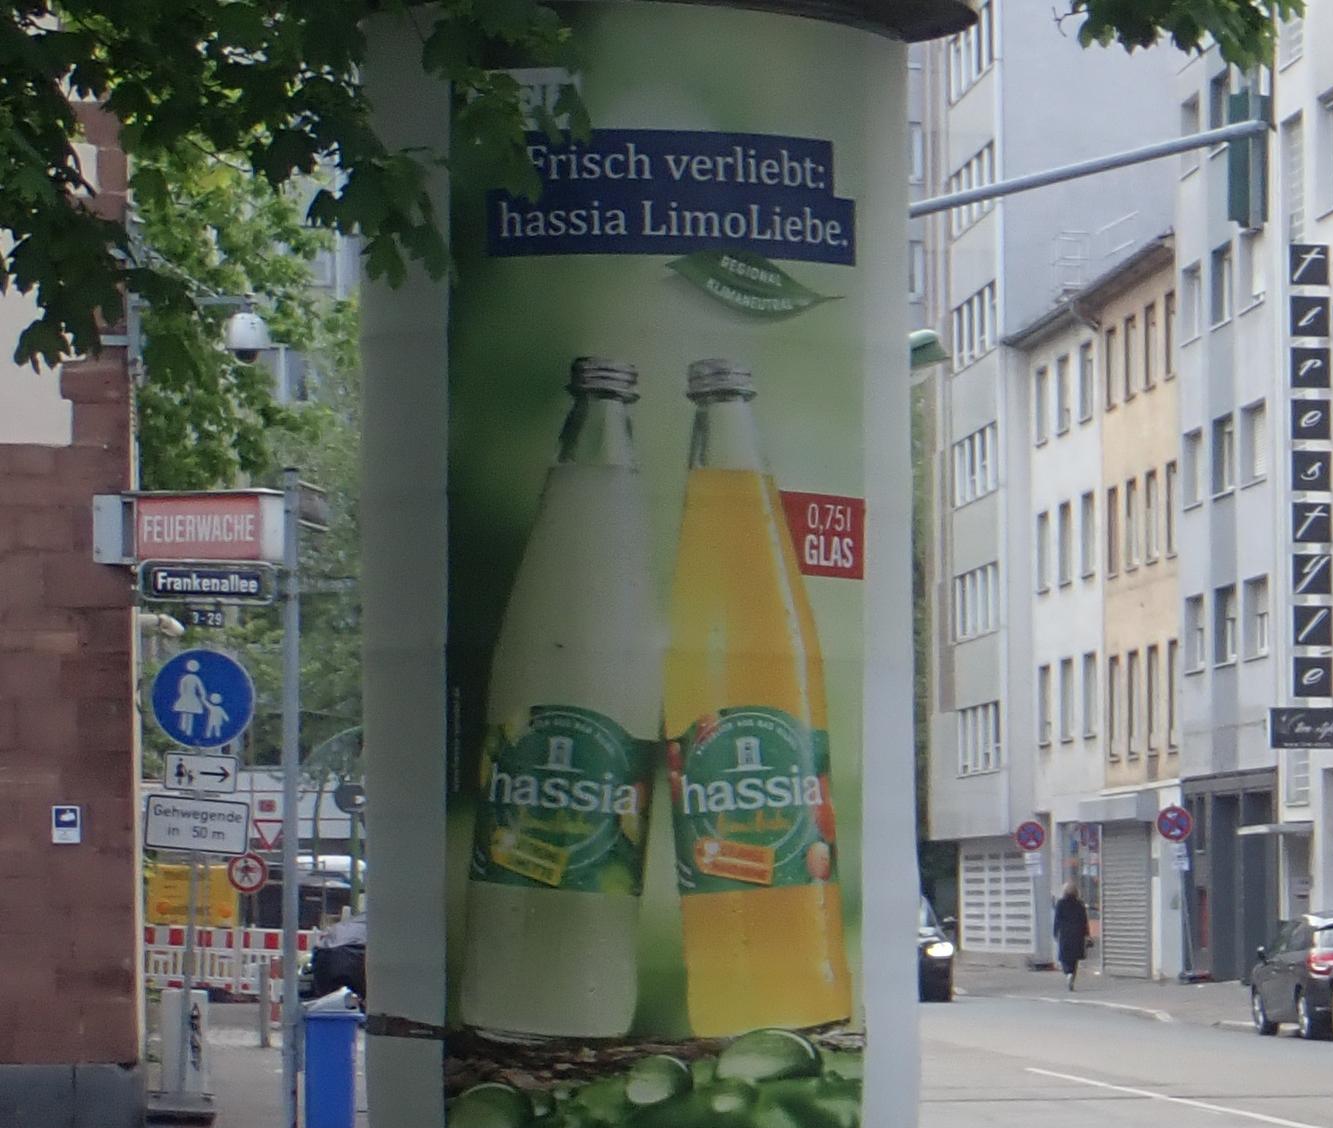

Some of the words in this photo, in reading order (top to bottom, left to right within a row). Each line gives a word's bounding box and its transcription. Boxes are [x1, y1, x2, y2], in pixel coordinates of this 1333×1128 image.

[525, 143, 653, 180] Frisch
[663, 145, 826, 190] verliebt:
[499, 200, 627, 238] hassia
[641, 200, 849, 247] LimoLiebe.
[720, 255, 782, 287] REGIONAL
[706, 278, 794, 312] KLIMANEUTRAL
[143, 514, 255, 543] FEUERWACHE
[804, 534, 854, 569] GLAS
[156, 571, 258, 593] Frankenallee
[489, 762, 639, 815] hassia
[681, 764, 823, 814] hassia
[153, 803, 243, 825] Gehwegende
[167, 824, 180, 837] in
[192, 825, 208, 840] 50
[211, 829, 225, 840] m
